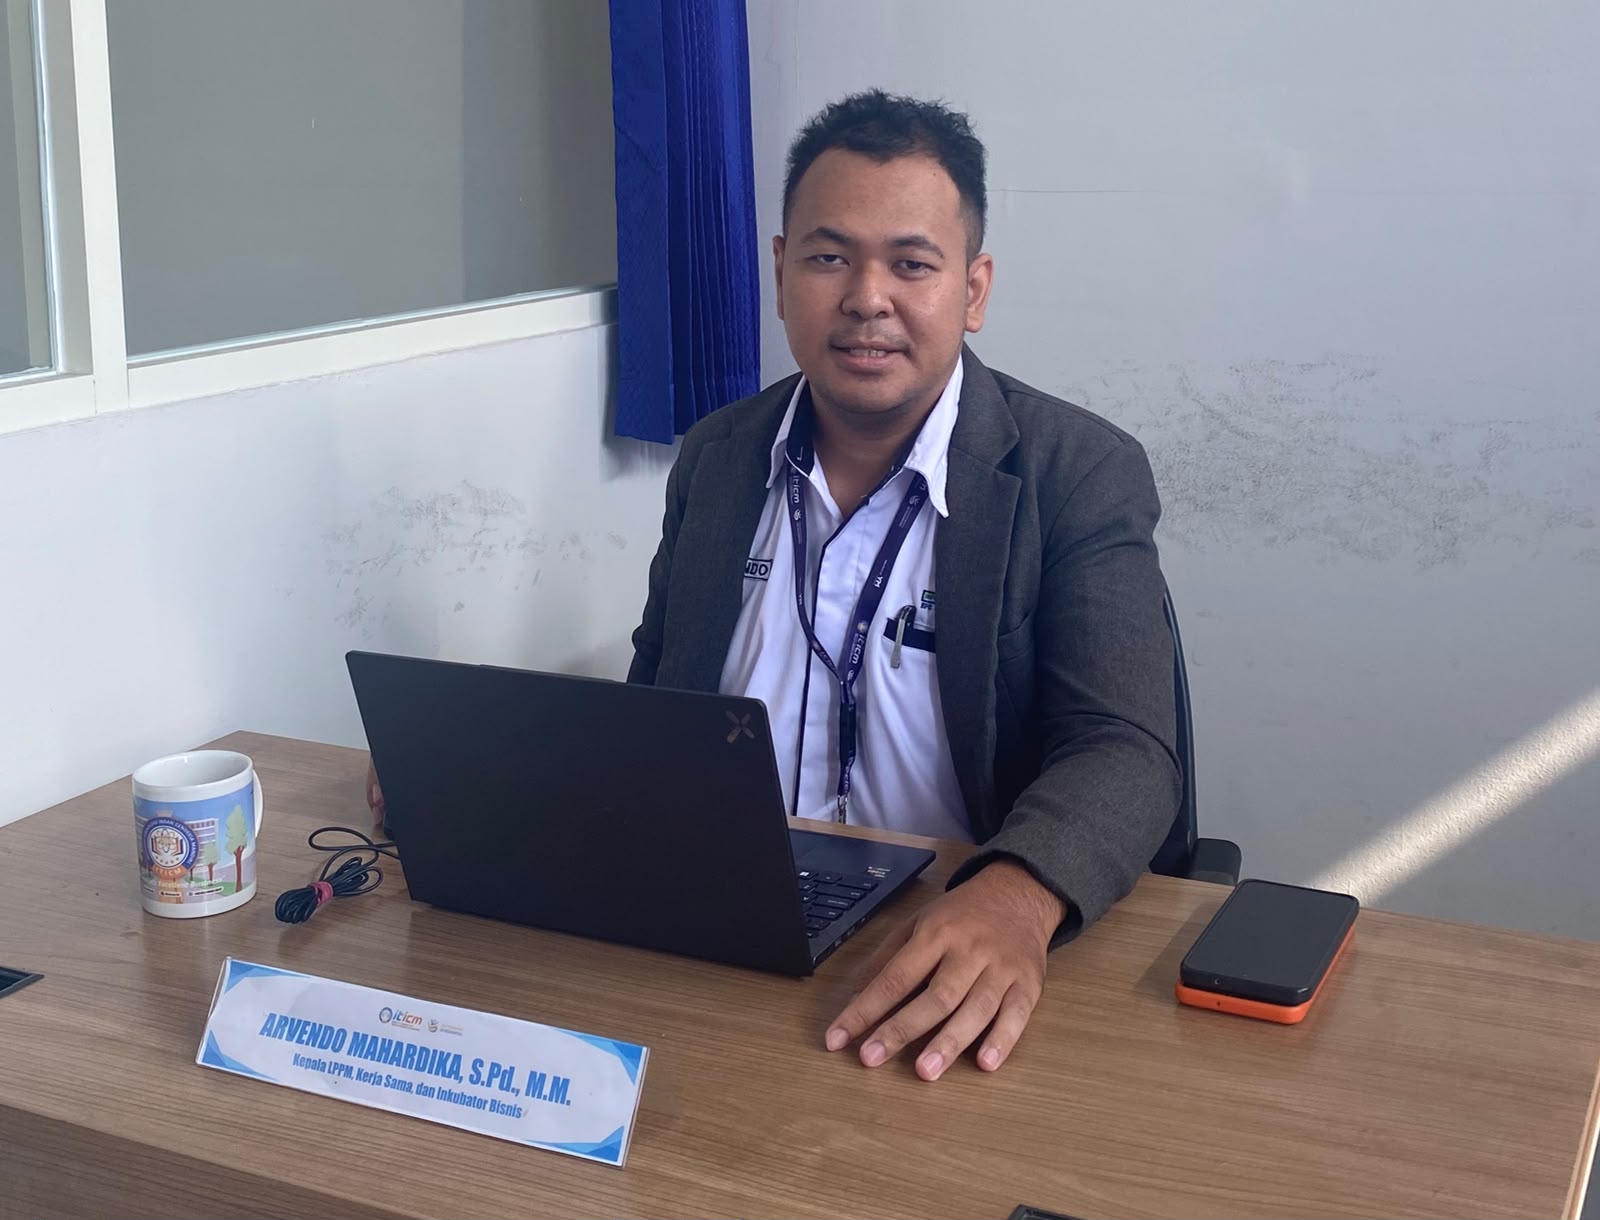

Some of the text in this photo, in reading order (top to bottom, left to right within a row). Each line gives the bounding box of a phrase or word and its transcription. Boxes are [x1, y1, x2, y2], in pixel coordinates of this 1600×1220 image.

[392, 1009, 423, 1025] iticm
[259, 1012, 571, 1106] ARVENDO MAHARDIKA, S.Pd., M.M.
[292, 1053, 523, 1119] Kepala LPPM, Kerja Sama, dan Inkubator Bisnis
